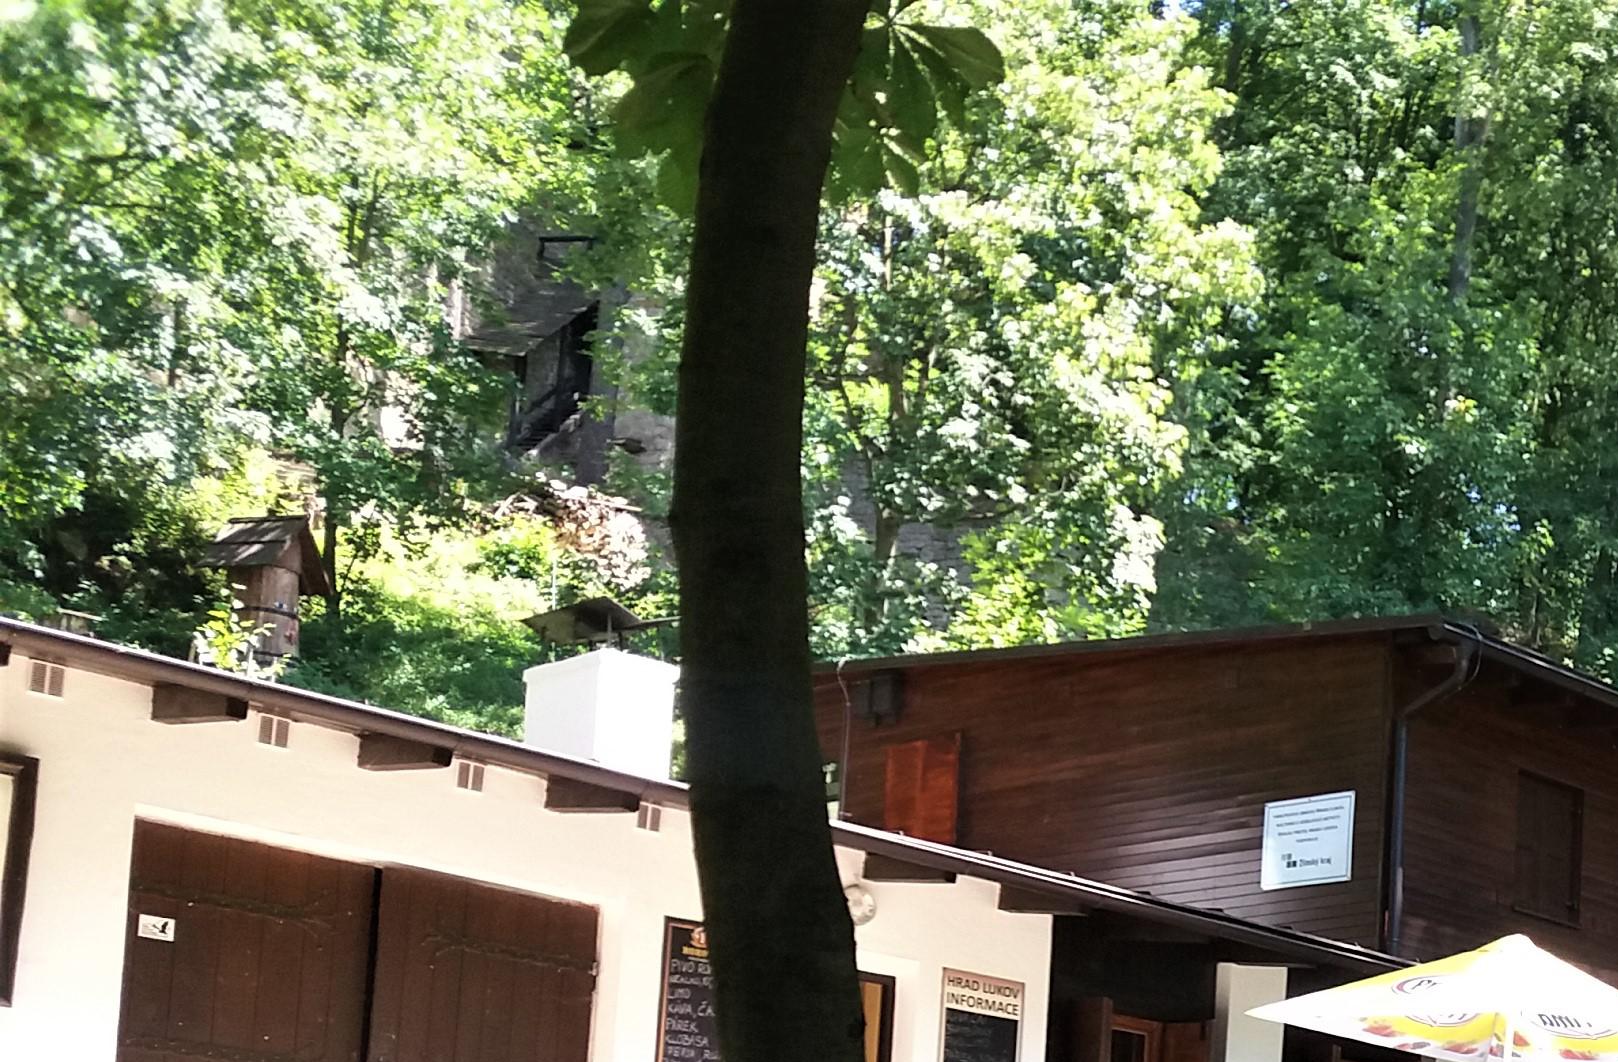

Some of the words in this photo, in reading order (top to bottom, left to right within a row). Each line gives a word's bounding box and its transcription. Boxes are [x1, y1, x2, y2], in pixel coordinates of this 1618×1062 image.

[947, 975, 980, 992] HRAD
[982, 982, 1019, 999] LUKOV
[946, 992, 1019, 1016] INFORMACE
